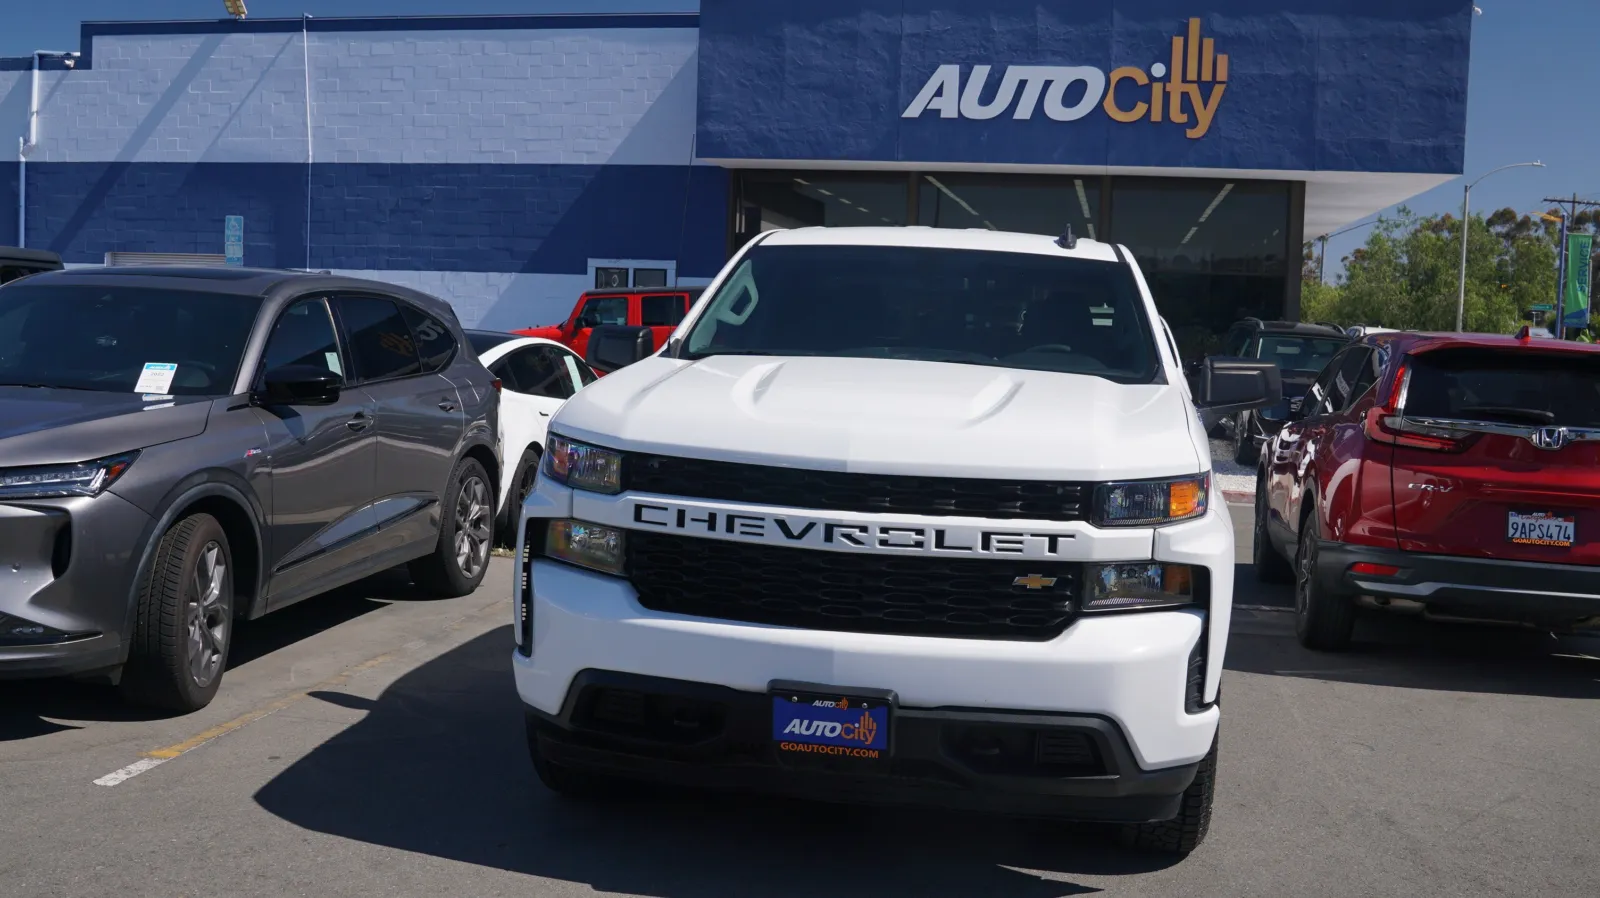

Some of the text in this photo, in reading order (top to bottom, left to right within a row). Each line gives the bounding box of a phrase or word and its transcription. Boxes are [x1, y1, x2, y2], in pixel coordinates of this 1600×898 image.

[1577, 242, 1589, 293] SERVICE
[633, 503, 1076, 555] CHEVROLET
[1511, 521, 1571, 541] 9APS474
[1512, 538, 1570, 547] GOAUTOCITY.COM
[780, 742, 879, 758] GOAUTOCITY.COM
